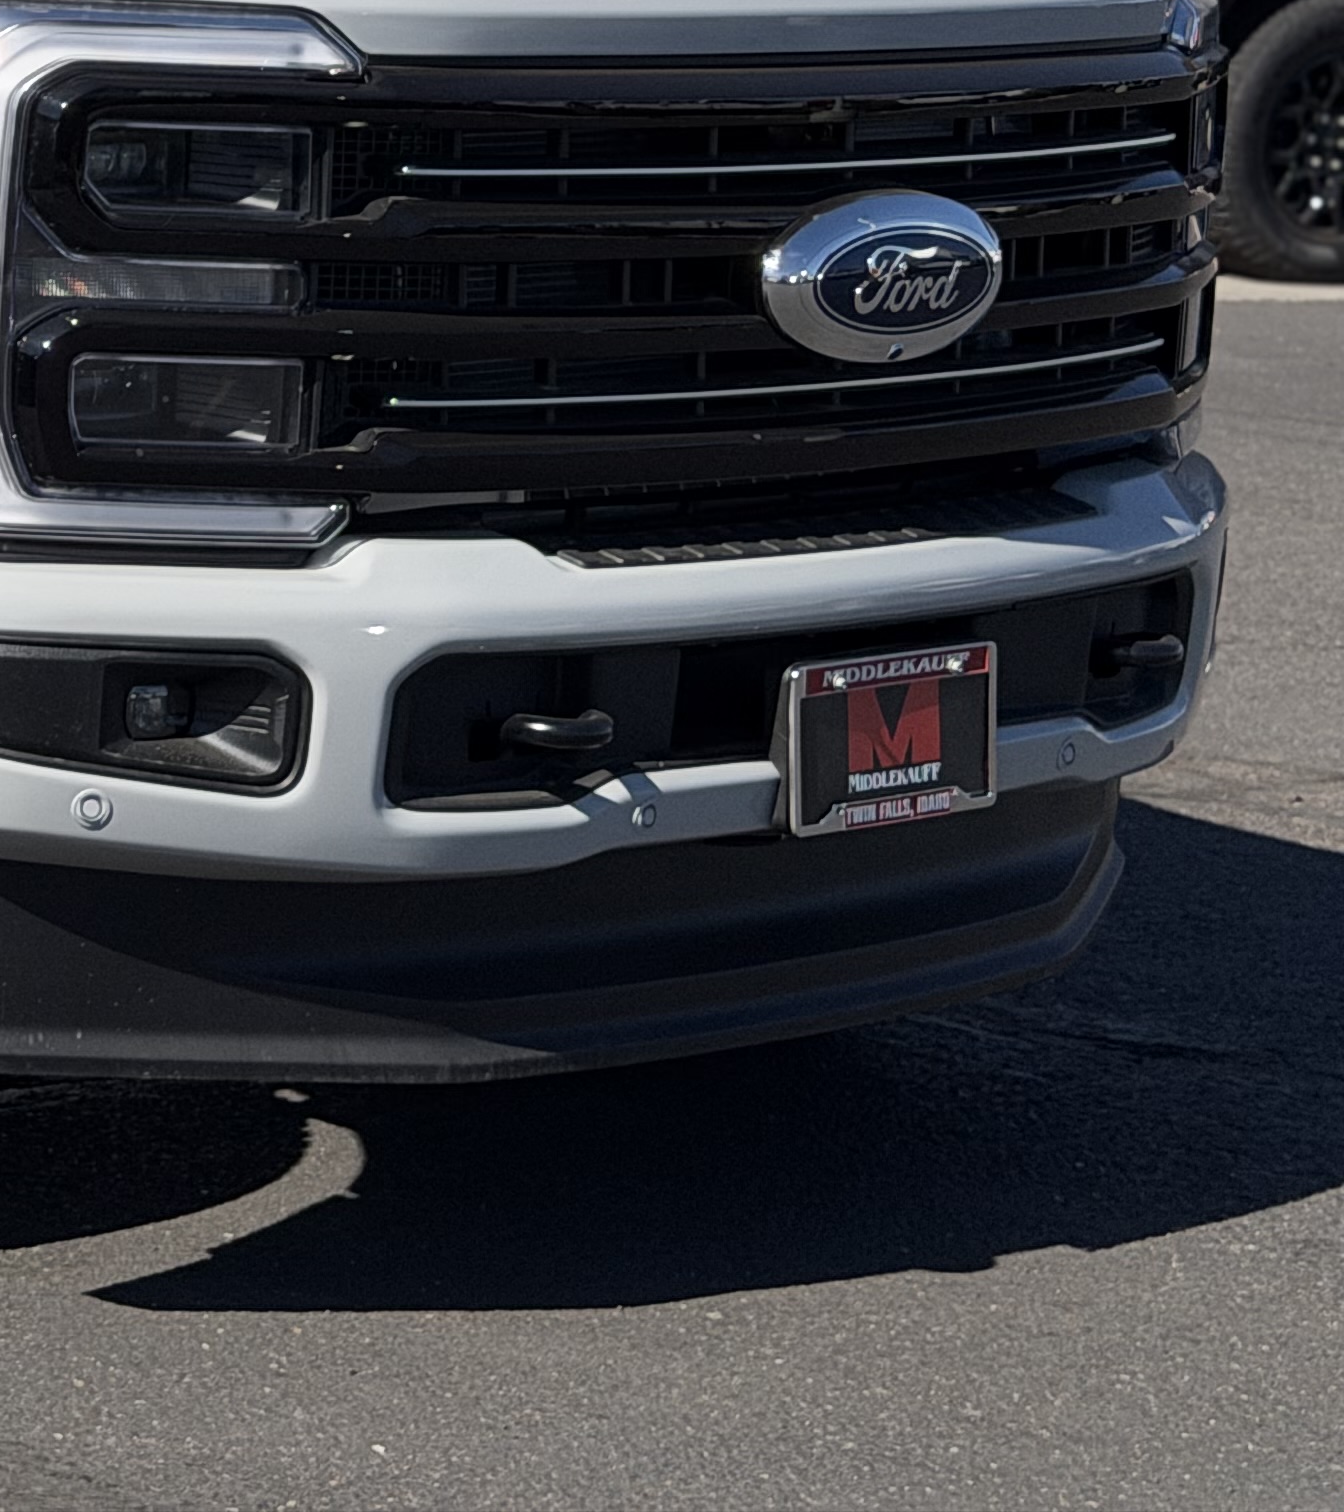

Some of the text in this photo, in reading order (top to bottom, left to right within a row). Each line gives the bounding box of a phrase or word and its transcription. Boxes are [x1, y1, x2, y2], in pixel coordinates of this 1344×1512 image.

[854, 245, 963, 315] Ford
[847, 679, 941, 773] M
[848, 762, 941, 794] MIDDLEKAUFF
[846, 792, 950, 825] TWIN FALLS, IDAHO
